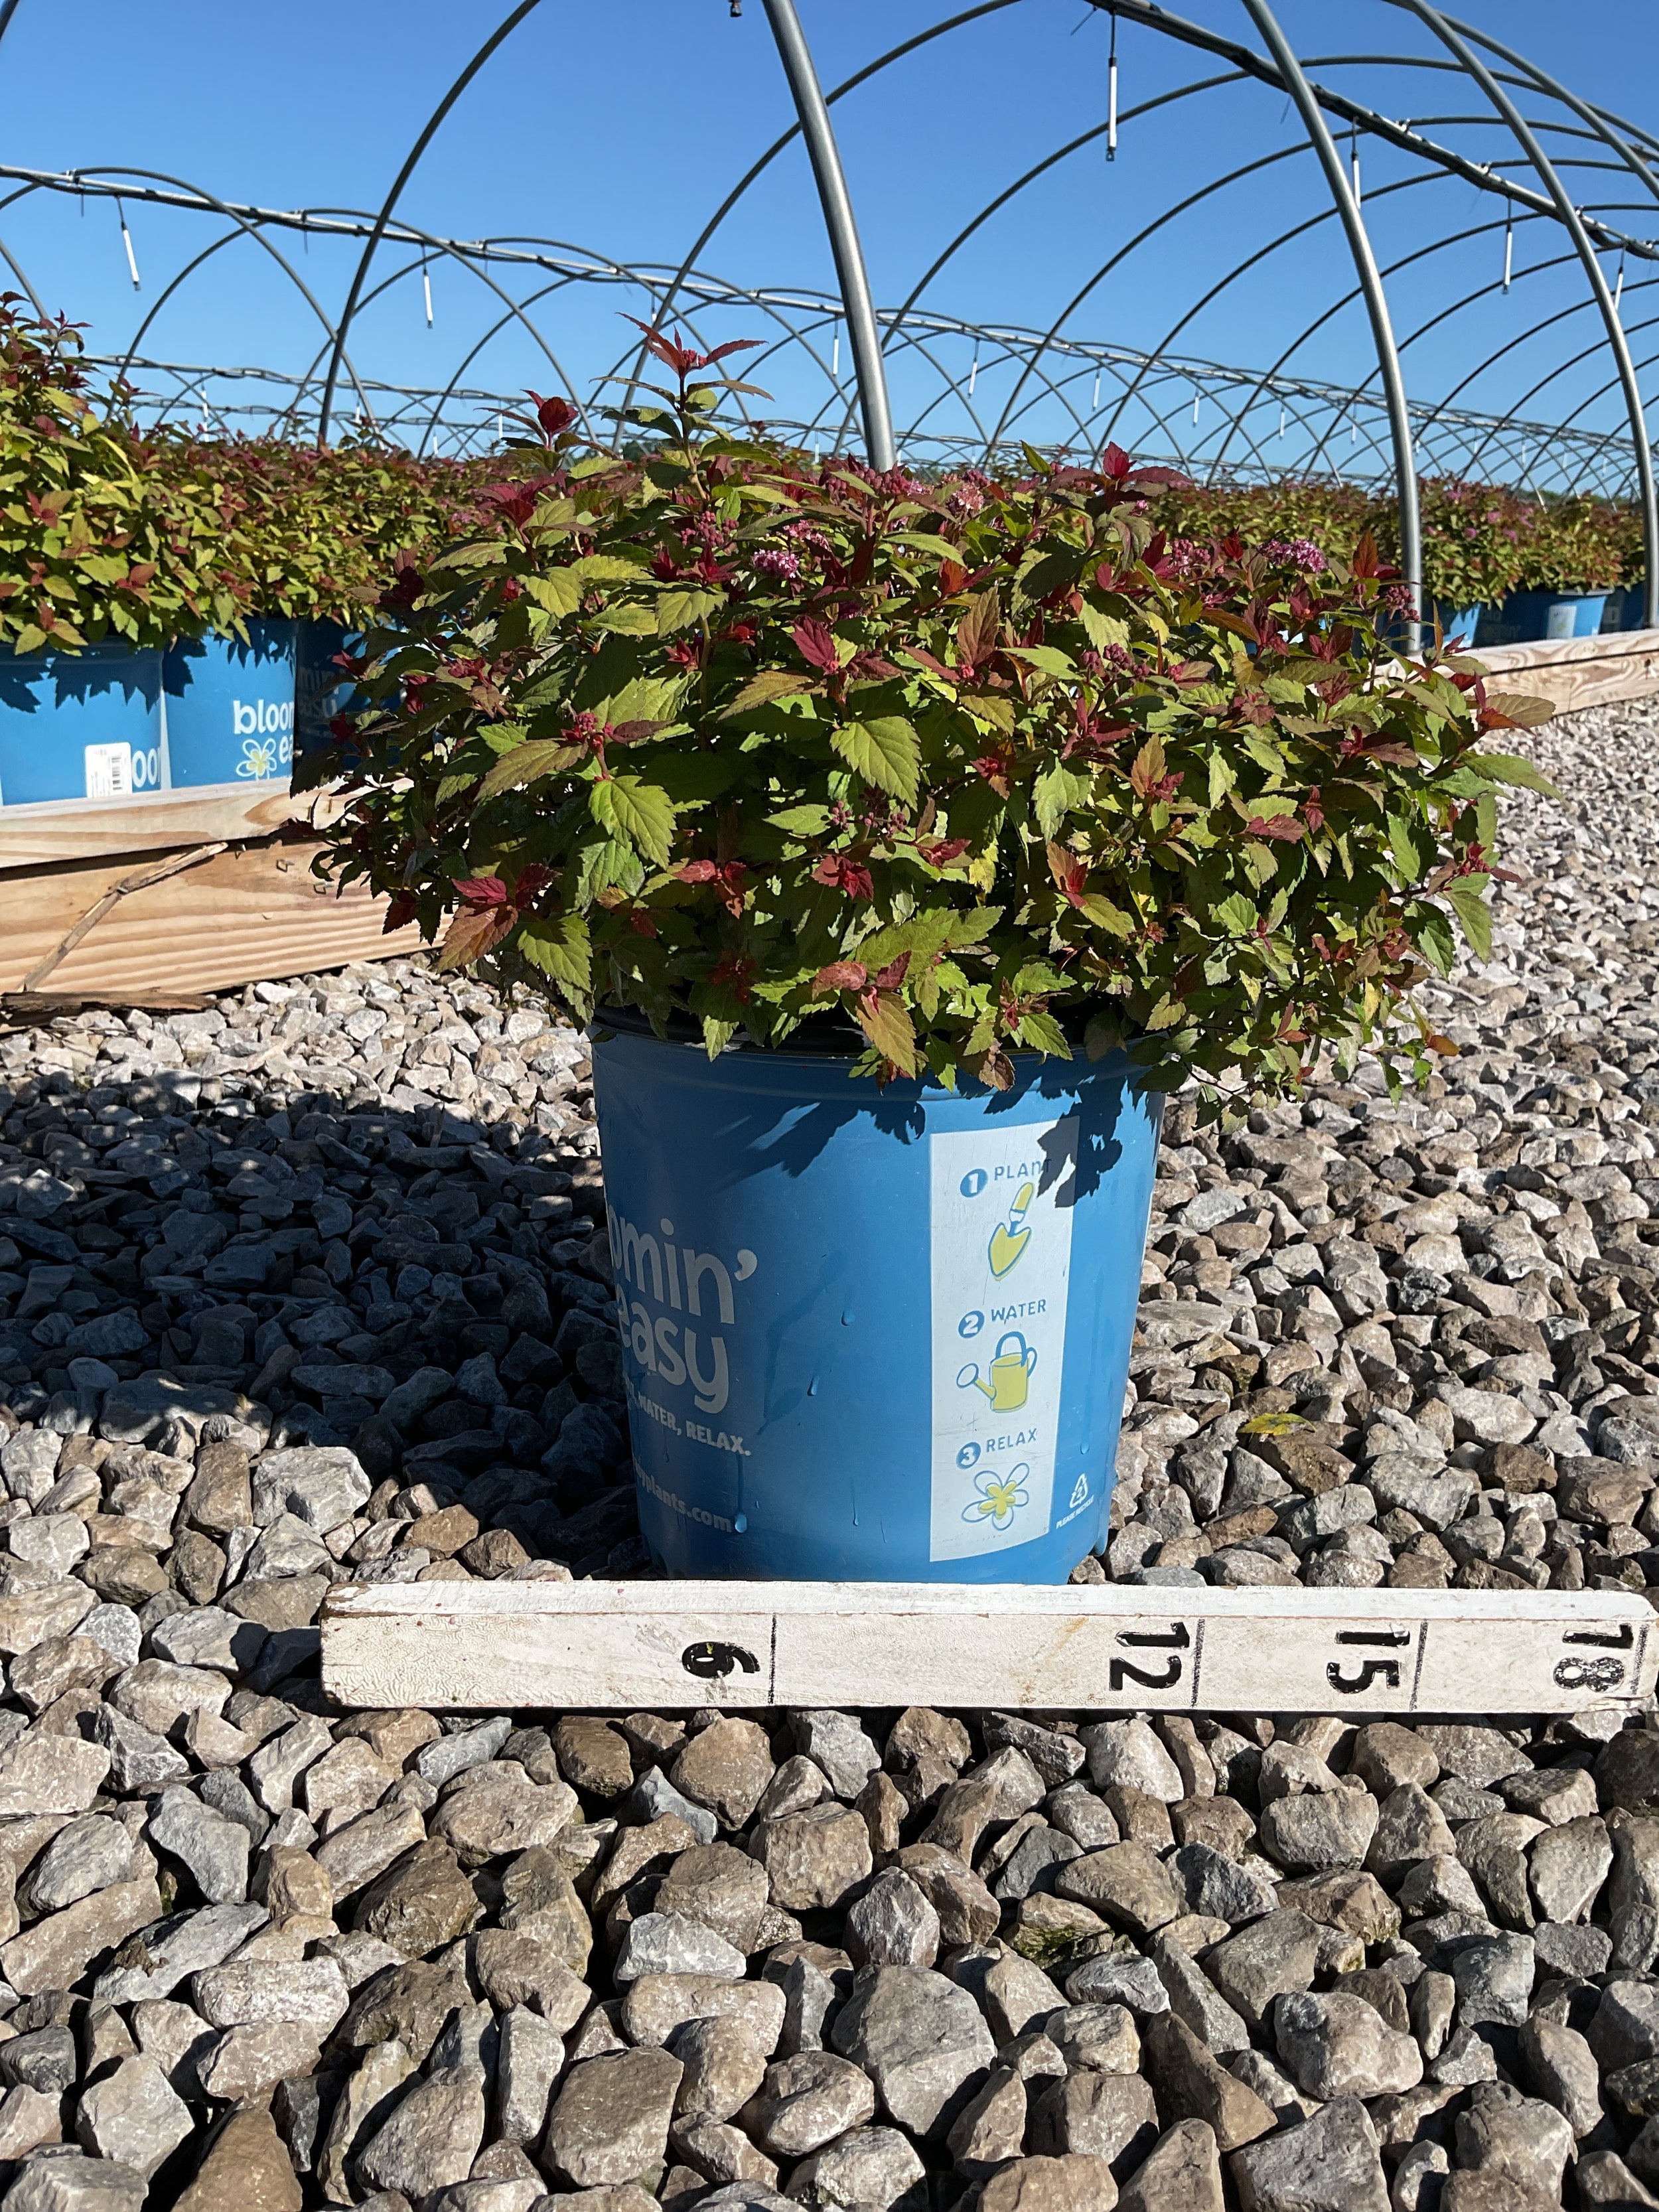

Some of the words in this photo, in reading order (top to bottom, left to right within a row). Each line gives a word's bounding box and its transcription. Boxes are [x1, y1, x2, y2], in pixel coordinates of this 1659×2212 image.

[991, 1299, 1046, 1323] WATER
[686, 1420, 752, 1456] RELAX.
[986, 1428, 1037, 1453] RELAX
[682, 1641, 760, 1678] 6
[1110, 1621, 1190, 1690] 12
[1327, 1630, 1410, 1694] 15
[1553, 1623, 1633, 1692] 18
